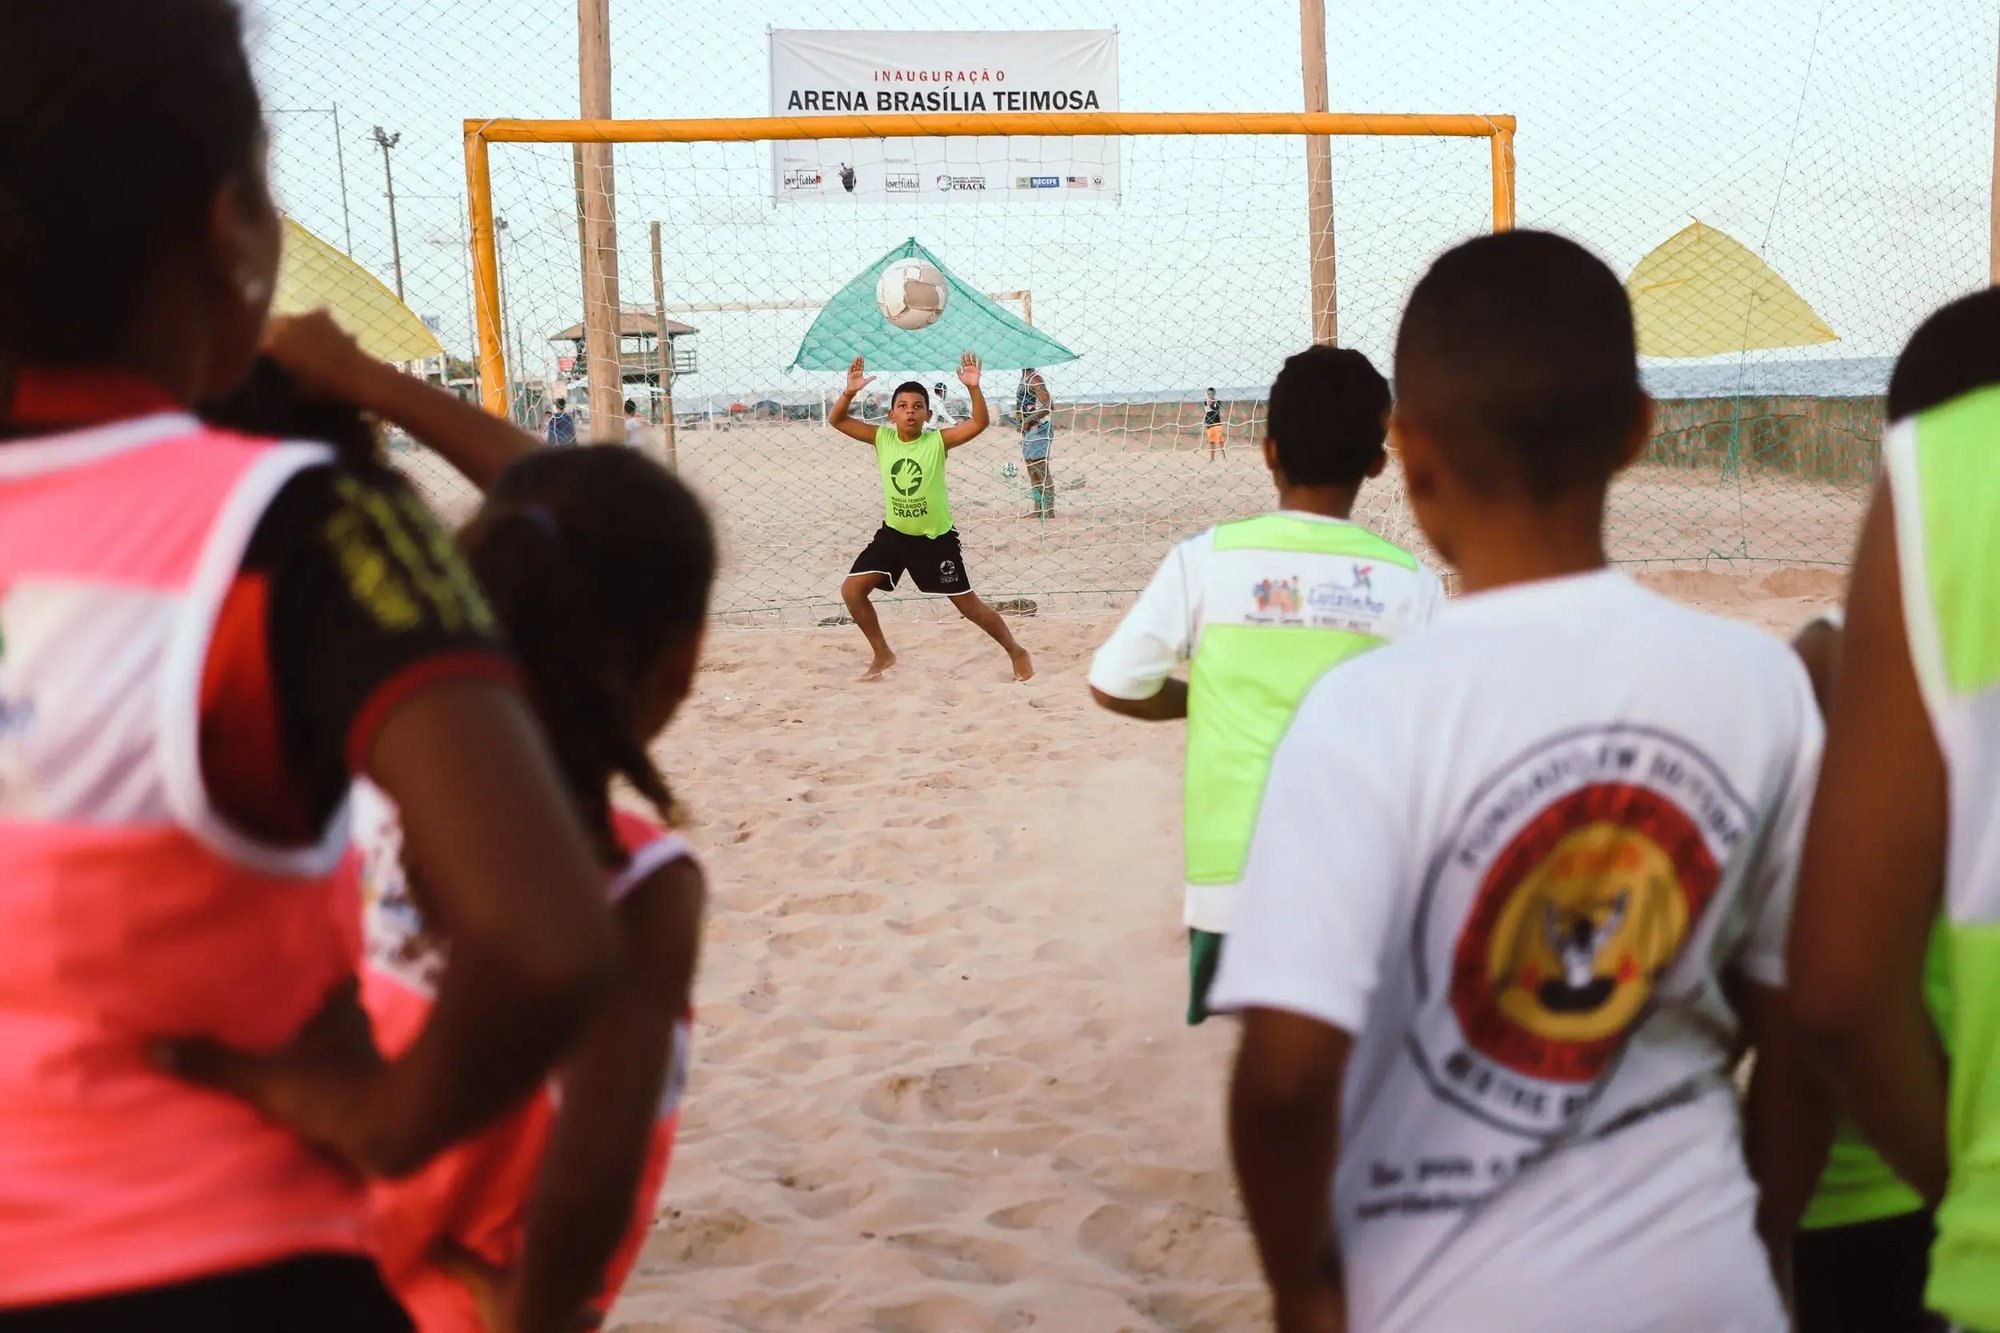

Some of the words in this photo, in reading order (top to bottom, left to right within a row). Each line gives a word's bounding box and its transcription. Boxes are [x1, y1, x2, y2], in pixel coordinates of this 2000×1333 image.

[875, 68, 1005, 84] INAUGURAÇÃO
[788, 90, 869, 111] ARENA
[877, 86, 986, 111] BRASÍLIA
[993, 90, 1100, 111] TEIMOSA
[893, 506, 928, 518] CRACK
